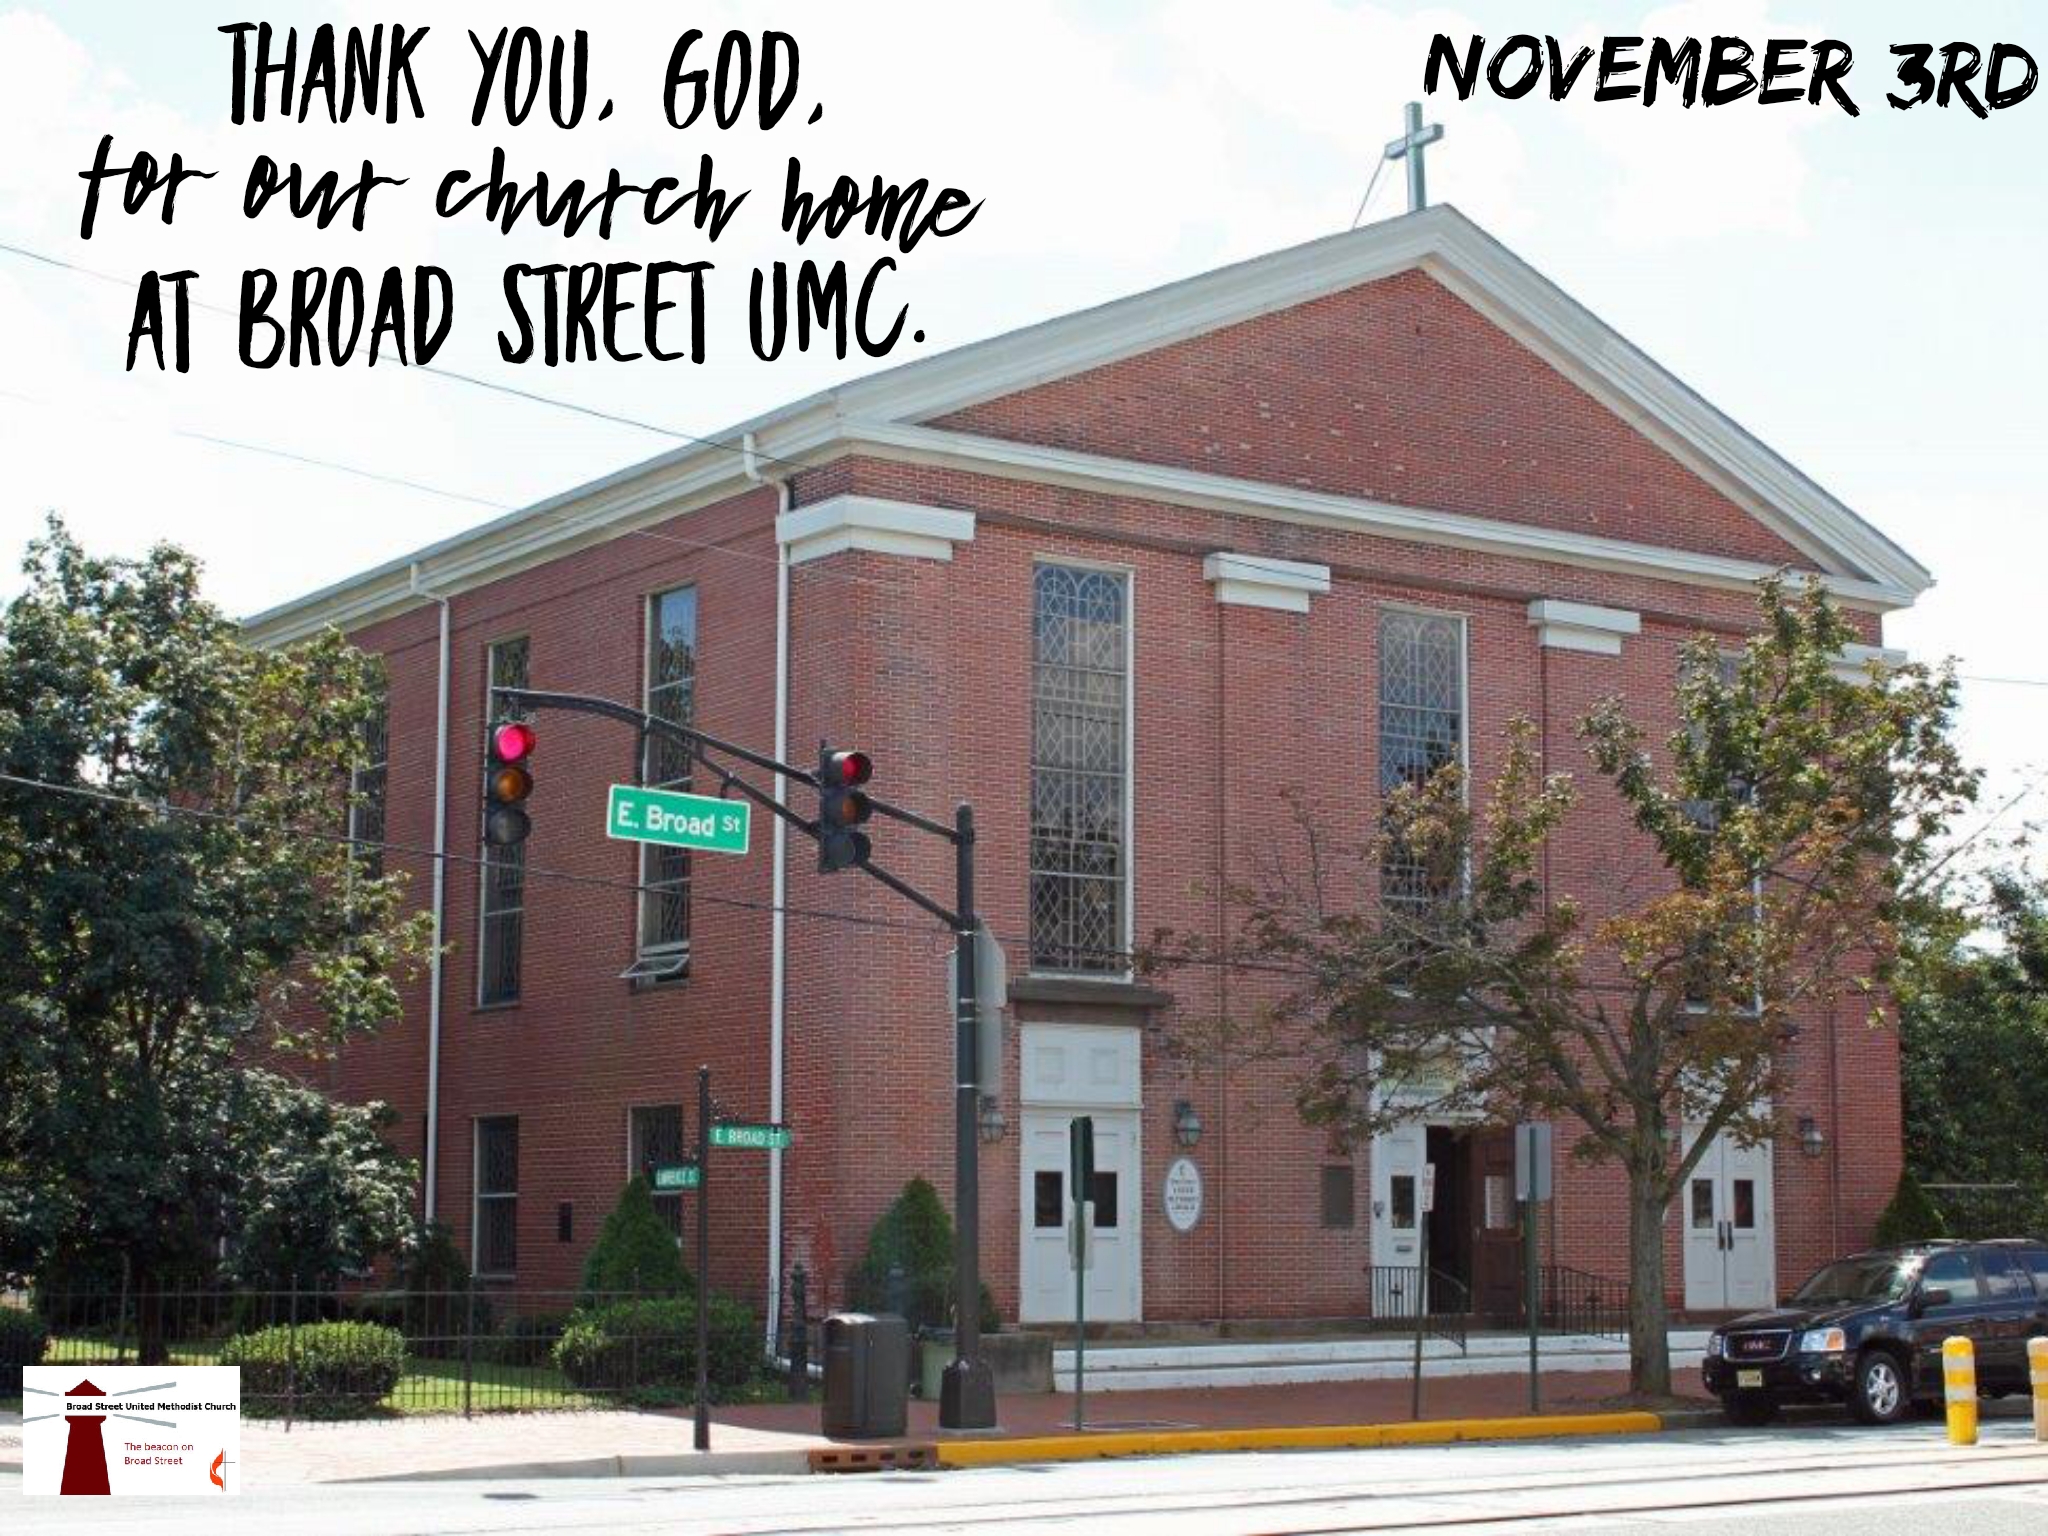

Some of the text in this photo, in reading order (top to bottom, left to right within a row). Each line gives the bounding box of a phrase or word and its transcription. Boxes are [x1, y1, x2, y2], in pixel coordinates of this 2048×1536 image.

[617, 801, 741, 838] E. Broad St
[715, 1128, 722, 1144] E
[728, 1128, 766, 1146] BROAD
